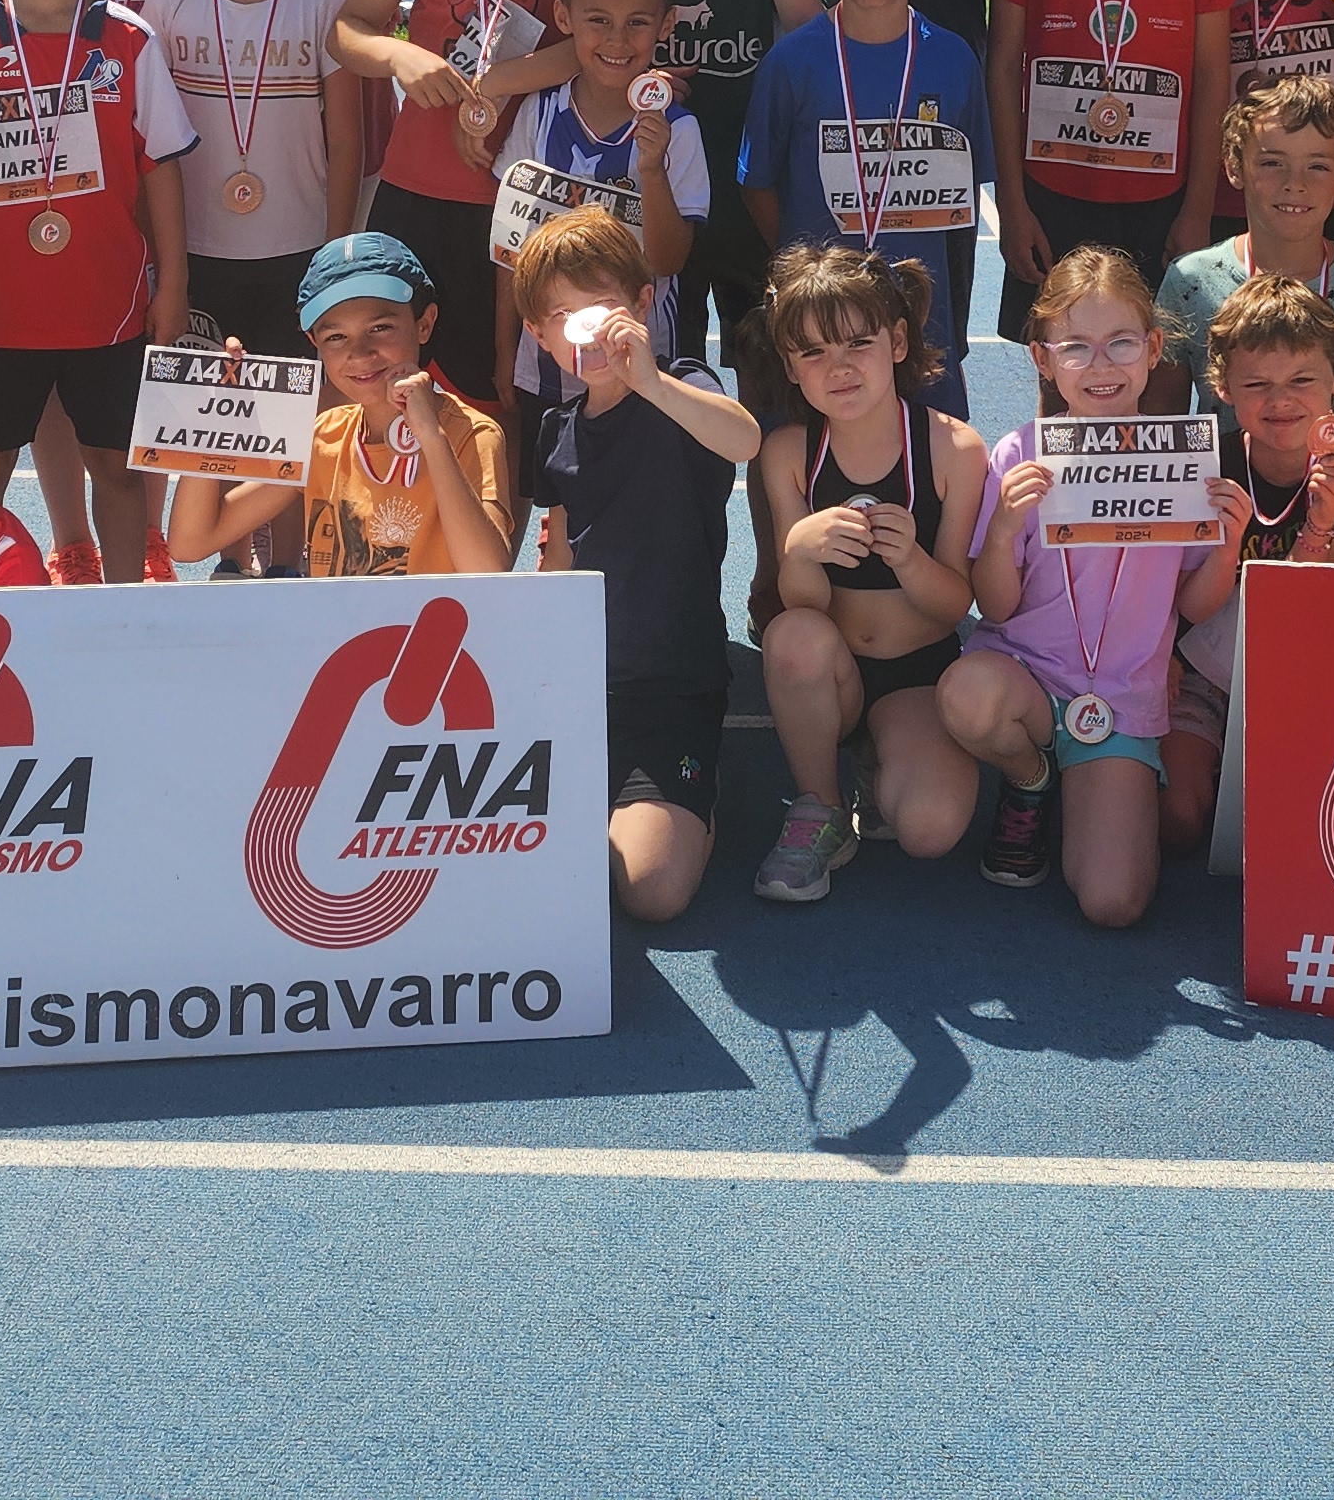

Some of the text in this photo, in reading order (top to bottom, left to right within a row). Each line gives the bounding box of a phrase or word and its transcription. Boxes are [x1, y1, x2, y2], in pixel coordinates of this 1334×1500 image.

[651, 31, 763, 66] cturale
[647, 92, 665, 100] FNA
[863, 160, 929, 177] MARC
[8, 188, 37, 199] 2024
[537, 175, 617, 215] A4XKM
[881, 219, 912, 227] 2024
[185, 357, 277, 389] A4XKM
[197, 398, 255, 418] JON
[154, 426, 287, 455] LATIENDA
[1082, 425, 1174, 452] A4XKM
[199, 462, 237, 473] 2024
[1061, 464, 1199, 485] MICHELLE
[1091, 498, 1173, 518] BRICE
[1115, 530, 1151, 540] 2024
[1086, 716, 1105, 725] FNA
[356, 739, 552, 823] FNA
[339, 820, 547, 860] ATLETISMO
